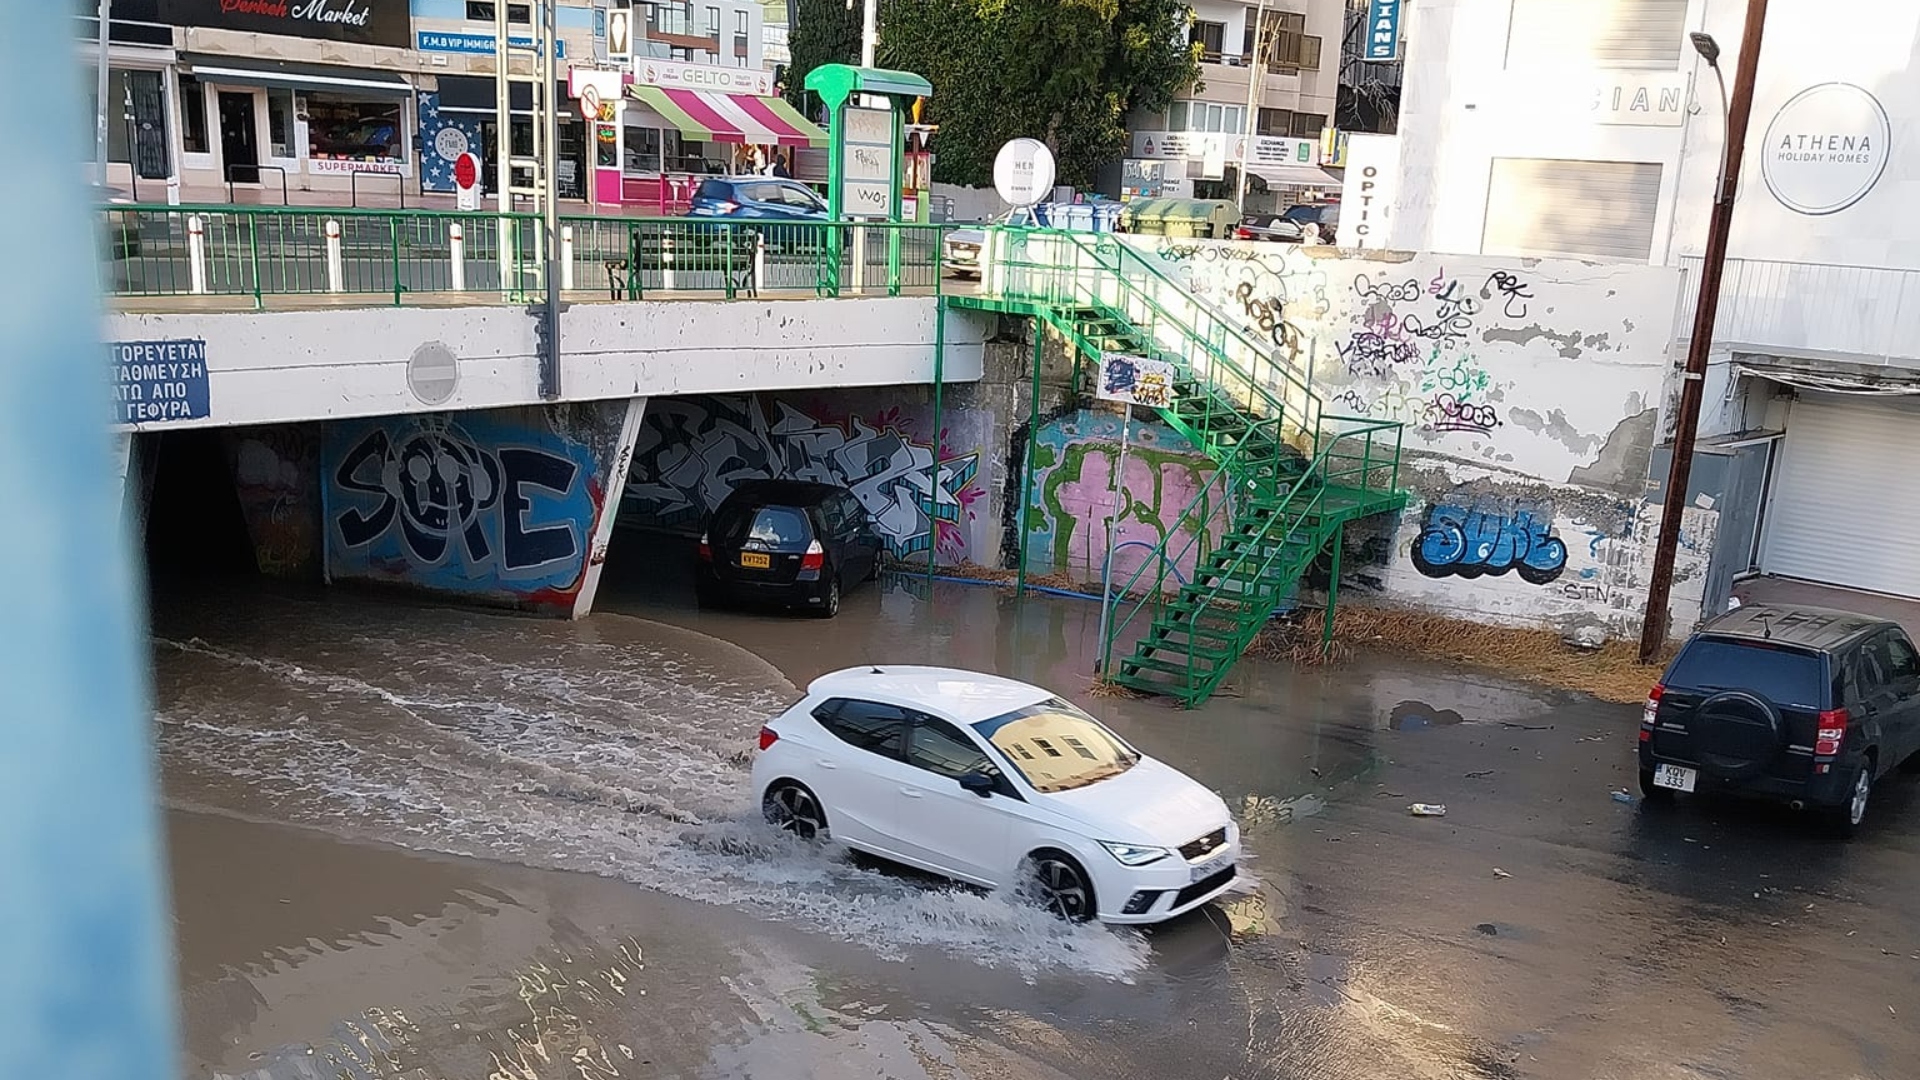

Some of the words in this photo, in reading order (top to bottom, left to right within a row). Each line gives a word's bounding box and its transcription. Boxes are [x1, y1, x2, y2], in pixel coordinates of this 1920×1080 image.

[291, 0, 369, 26] Market
[449, 38, 461, 48] VIP
[683, 69, 731, 86] GELTO
[1780, 134, 1871, 151] ATHENA
[1779, 152, 1824, 162] HOLIDAY
[1829, 154, 1870, 164] HOMES
[318, 162, 401, 173] SUPERMARKET
[152, 382, 187, 399] ΑΠΟ
[127, 401, 191, 419] ΓΕΦΥΡΑ
[1664, 777, 1684, 788] 333
